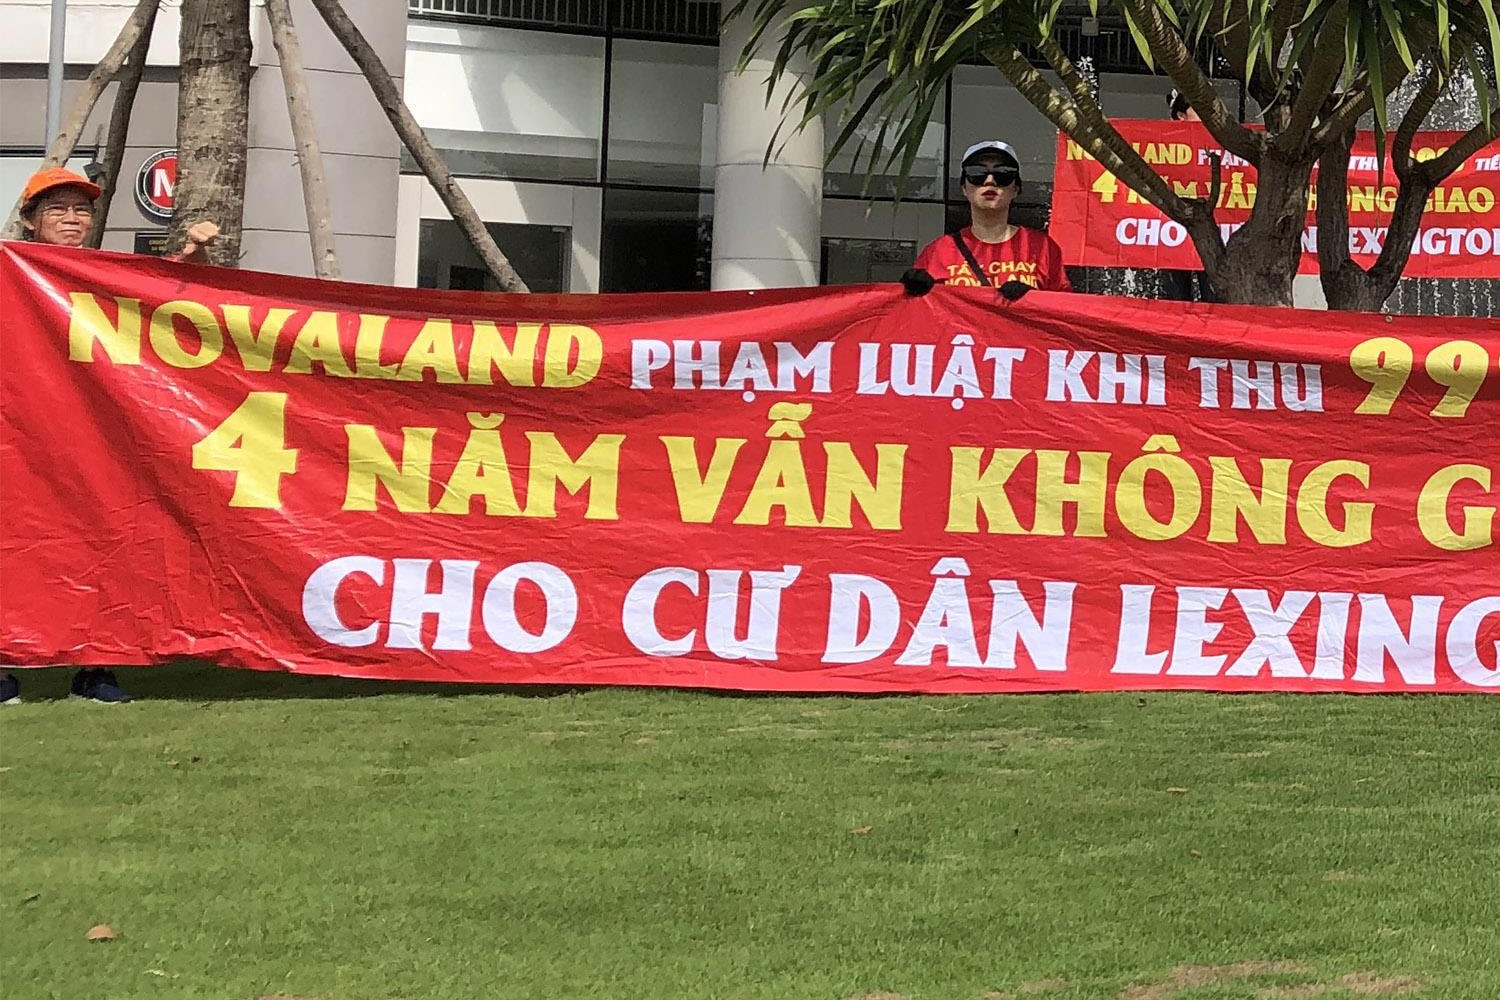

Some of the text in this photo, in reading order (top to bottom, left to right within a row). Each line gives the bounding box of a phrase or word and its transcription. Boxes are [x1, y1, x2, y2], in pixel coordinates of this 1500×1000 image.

[1091, 169, 1119, 203] 4
[988, 260, 1037, 274] CHAY
[1115, 217, 1189, 247] CHO
[68, 291, 604, 389] NOVALAND
[630, 338, 835, 403] PHẠM
[856, 335, 1027, 410] LUẬT
[1046, 348, 1170, 406] KHI
[1189, 356, 1325, 413] THU
[191, 391, 299, 510] 4
[342, 411, 628, 521] NĂM
[659, 401, 909, 531] VẪN
[944, 433, 1377, 548] KHÔNG
[302, 555, 580, 654] CHO
[622, 564, 803, 662] CƯ
[821, 556, 1077, 673] DÂN
